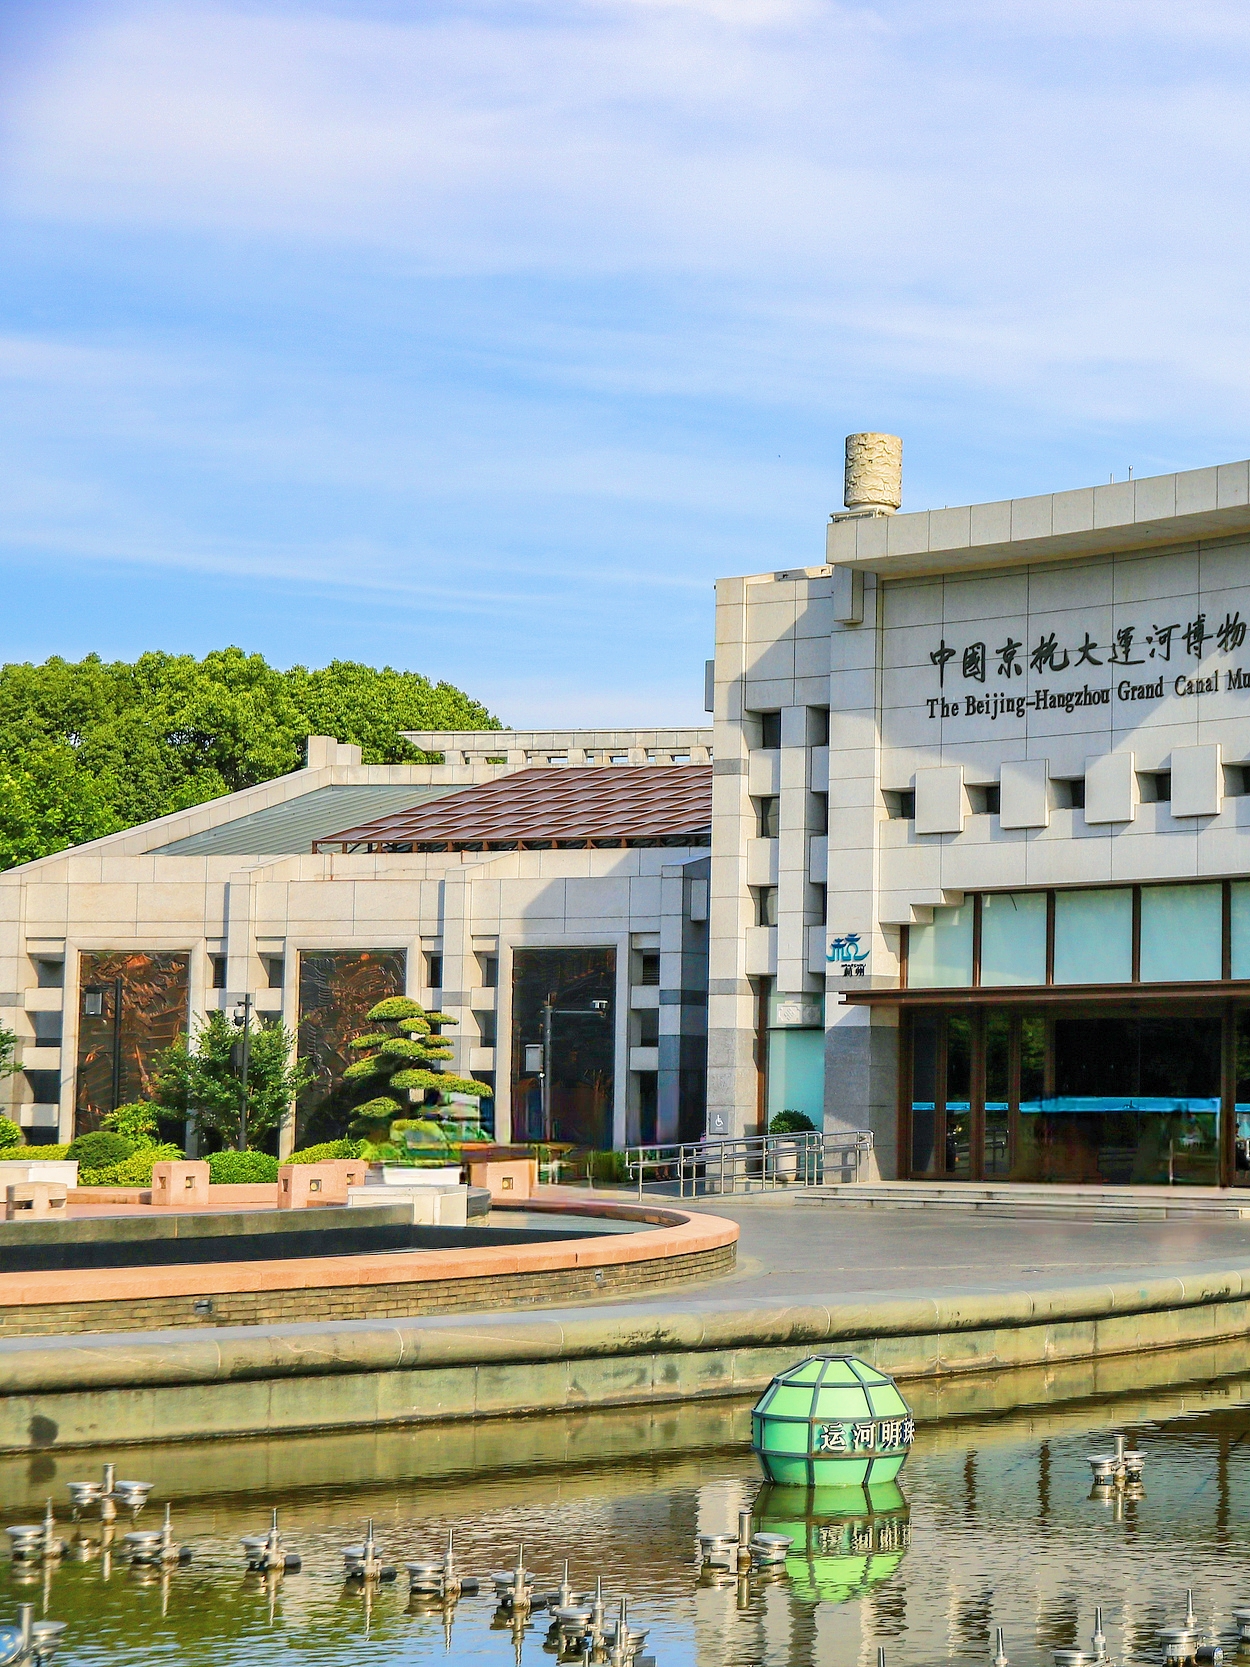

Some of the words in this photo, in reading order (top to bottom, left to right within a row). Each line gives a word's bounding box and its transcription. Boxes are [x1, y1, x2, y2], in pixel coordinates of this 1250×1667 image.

[926, 697, 960, 719] The
[964, 684, 1110, 720] Beijing-Hangzhou
[1117, 675, 1165, 702] Grand
[1174, 668, 1219, 697] Canal
[820, 1418, 916, 1451] 运河明珠
